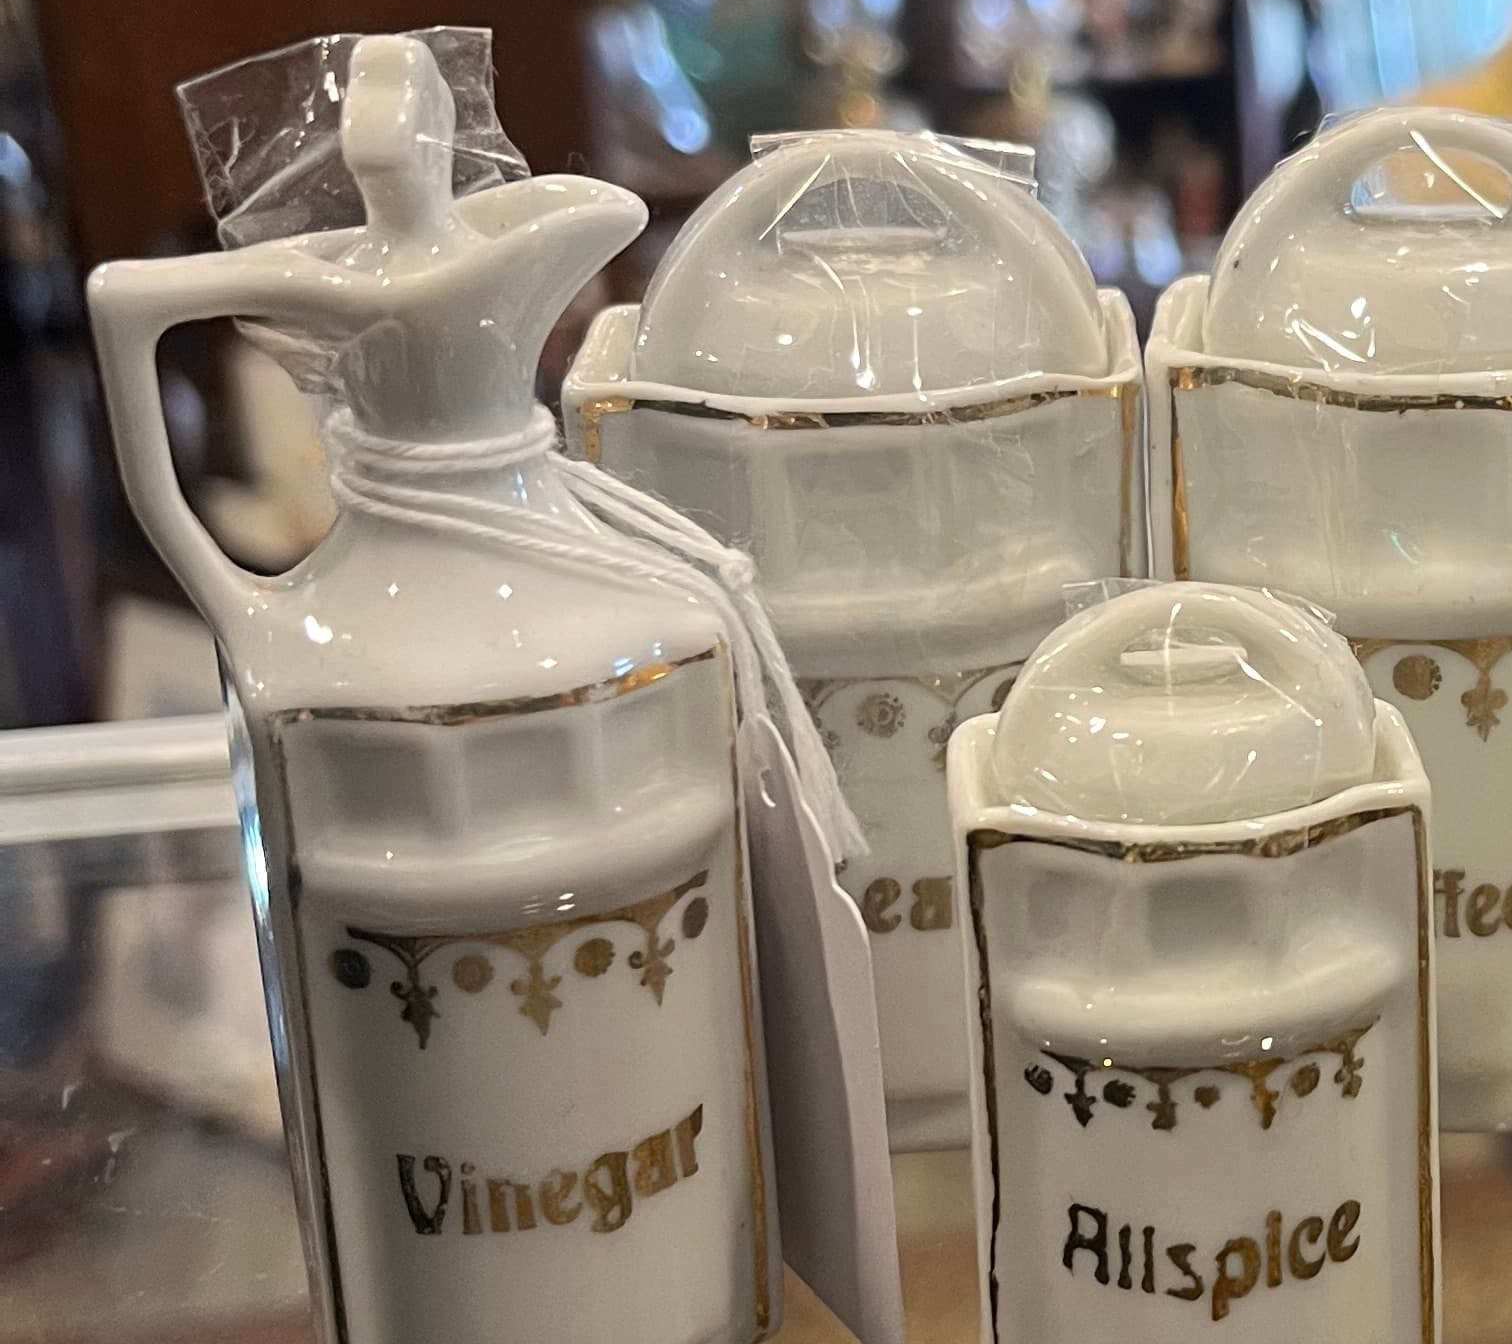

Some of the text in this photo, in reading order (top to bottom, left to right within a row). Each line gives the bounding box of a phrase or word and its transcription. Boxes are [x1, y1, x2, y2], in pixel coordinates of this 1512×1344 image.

[836, 859, 954, 934] ea
[396, 1102, 704, 1235] Vinegar
[1062, 1199, 1361, 1322] Allspice
